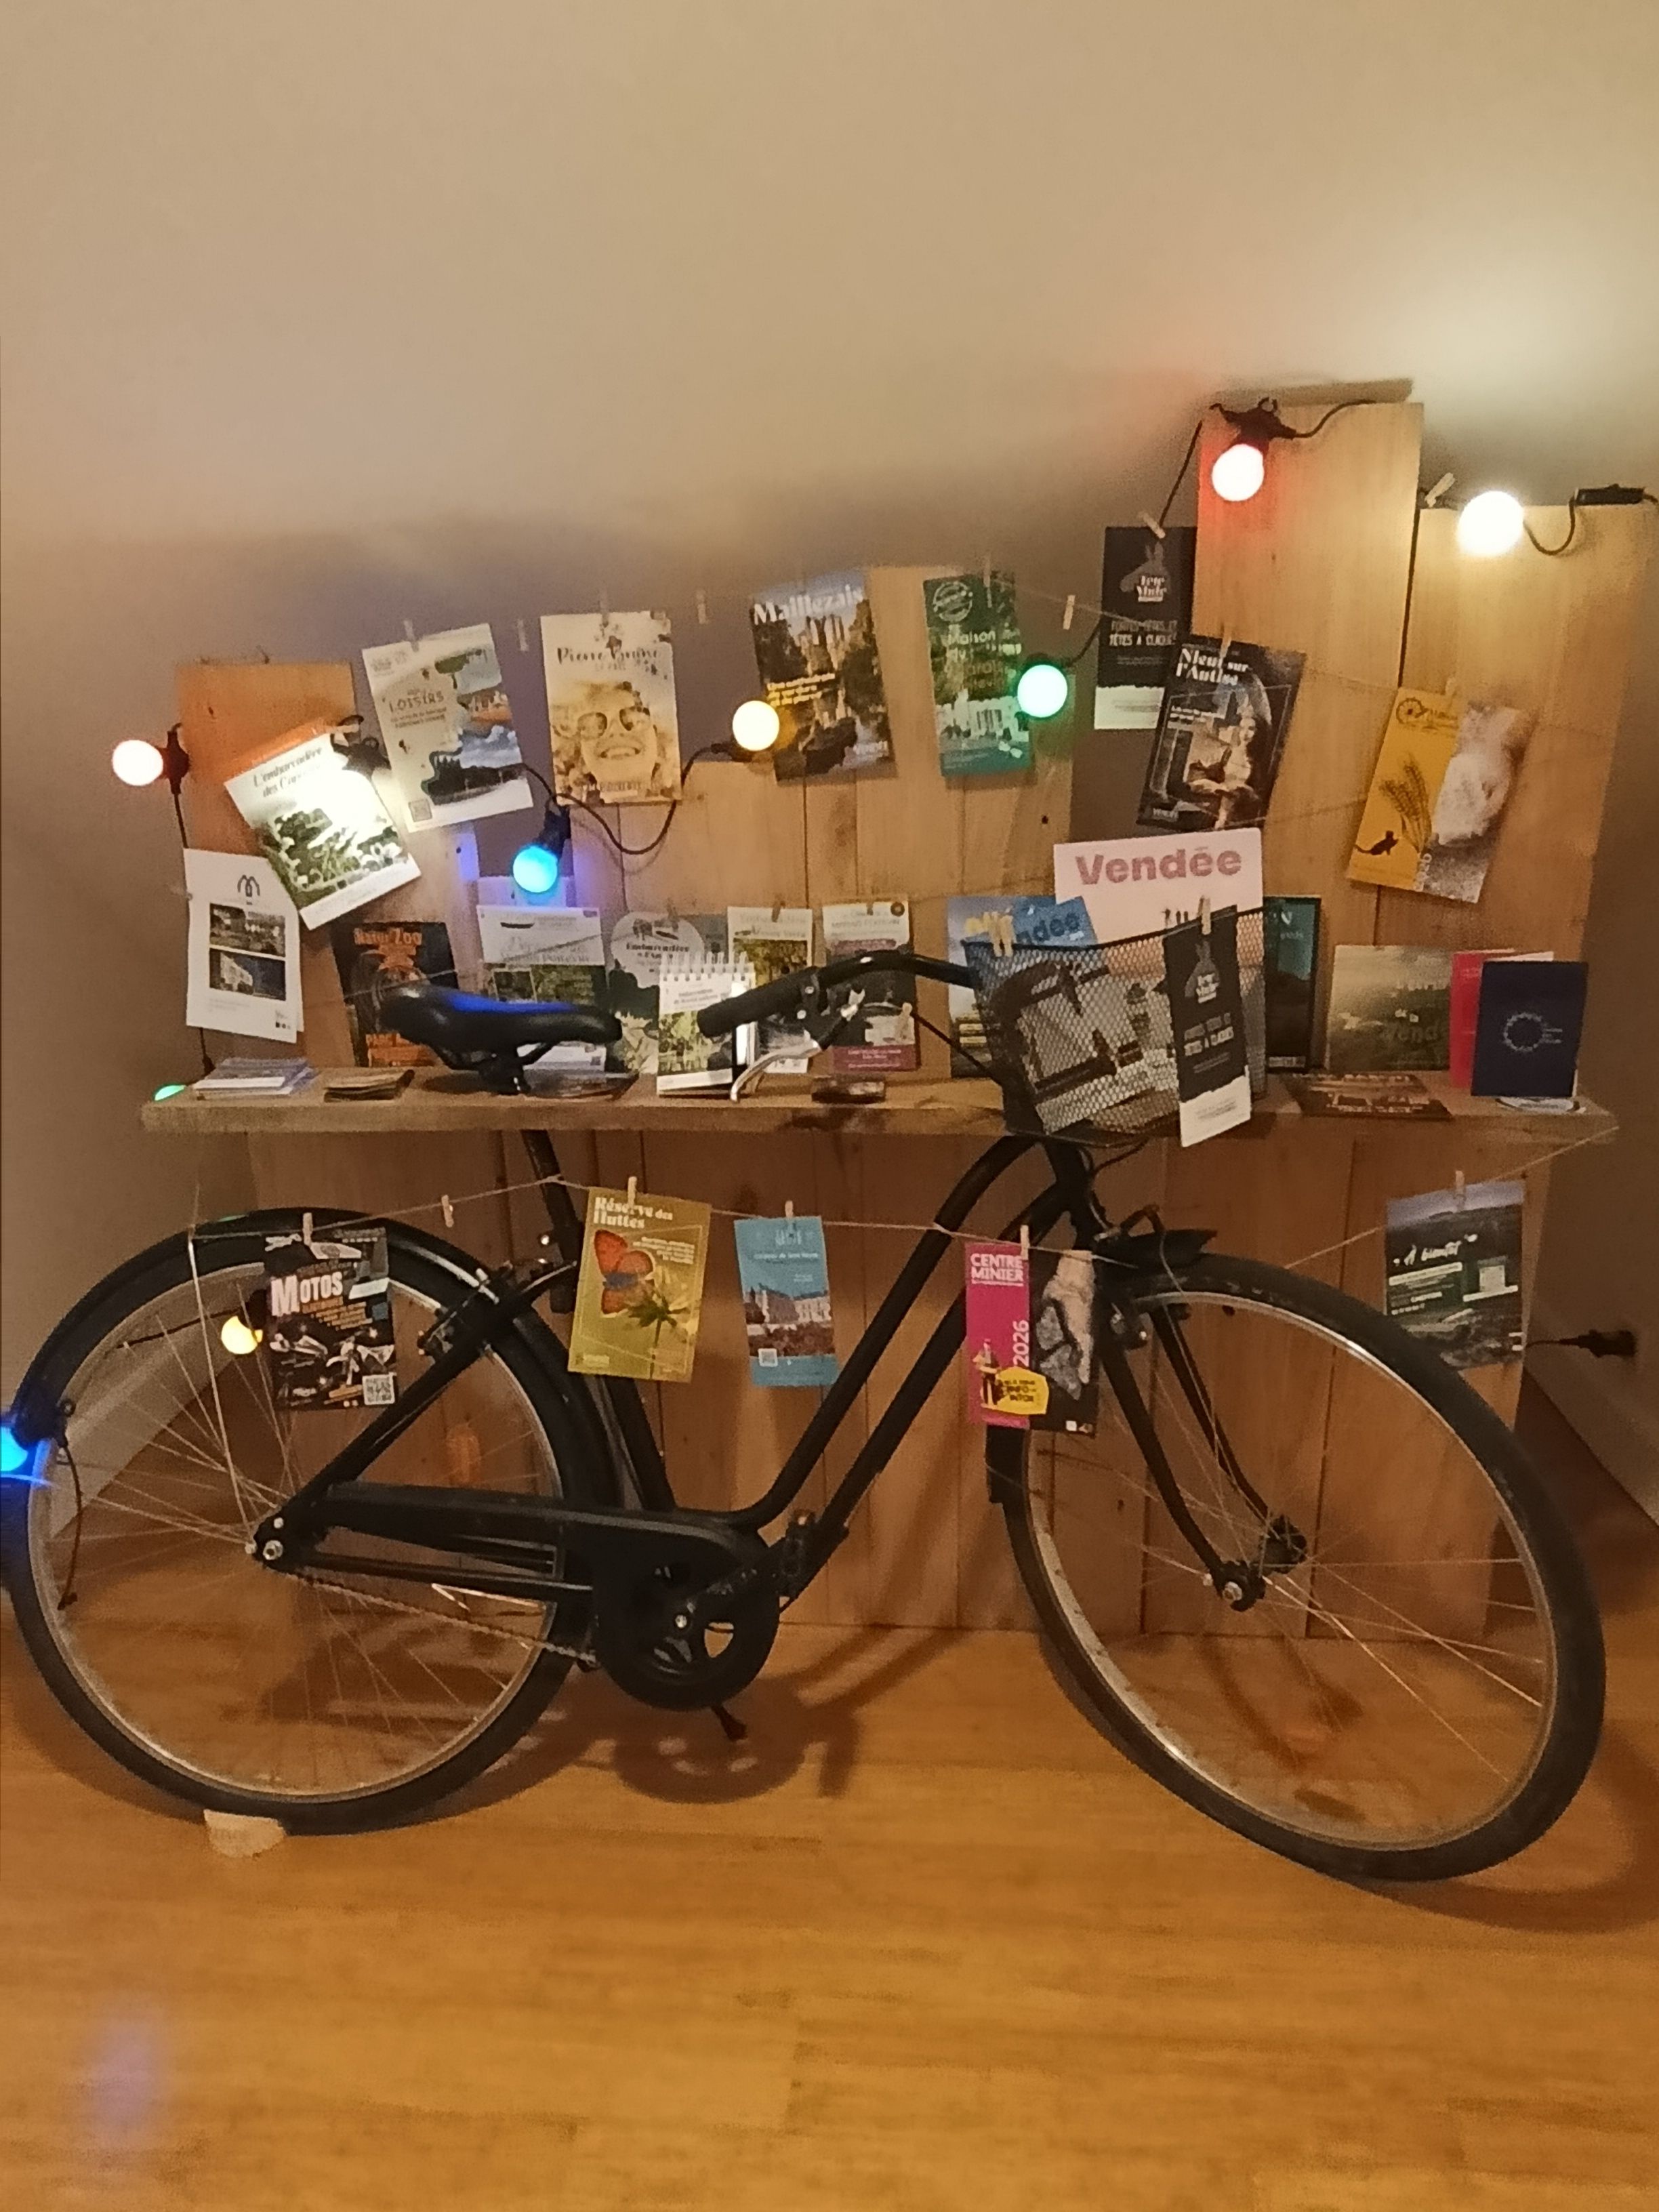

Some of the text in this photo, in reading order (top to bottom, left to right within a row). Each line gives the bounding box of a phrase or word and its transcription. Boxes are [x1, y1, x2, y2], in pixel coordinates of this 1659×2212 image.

[1075, 846, 1242, 885] Vendée
[970, 1252, 1024, 1269] CENTRE
[970, 1266, 1025, 1282] MINIER
[271, 1271, 344, 1317] MOTOS
[1012, 1319, 1029, 1368] 2026
